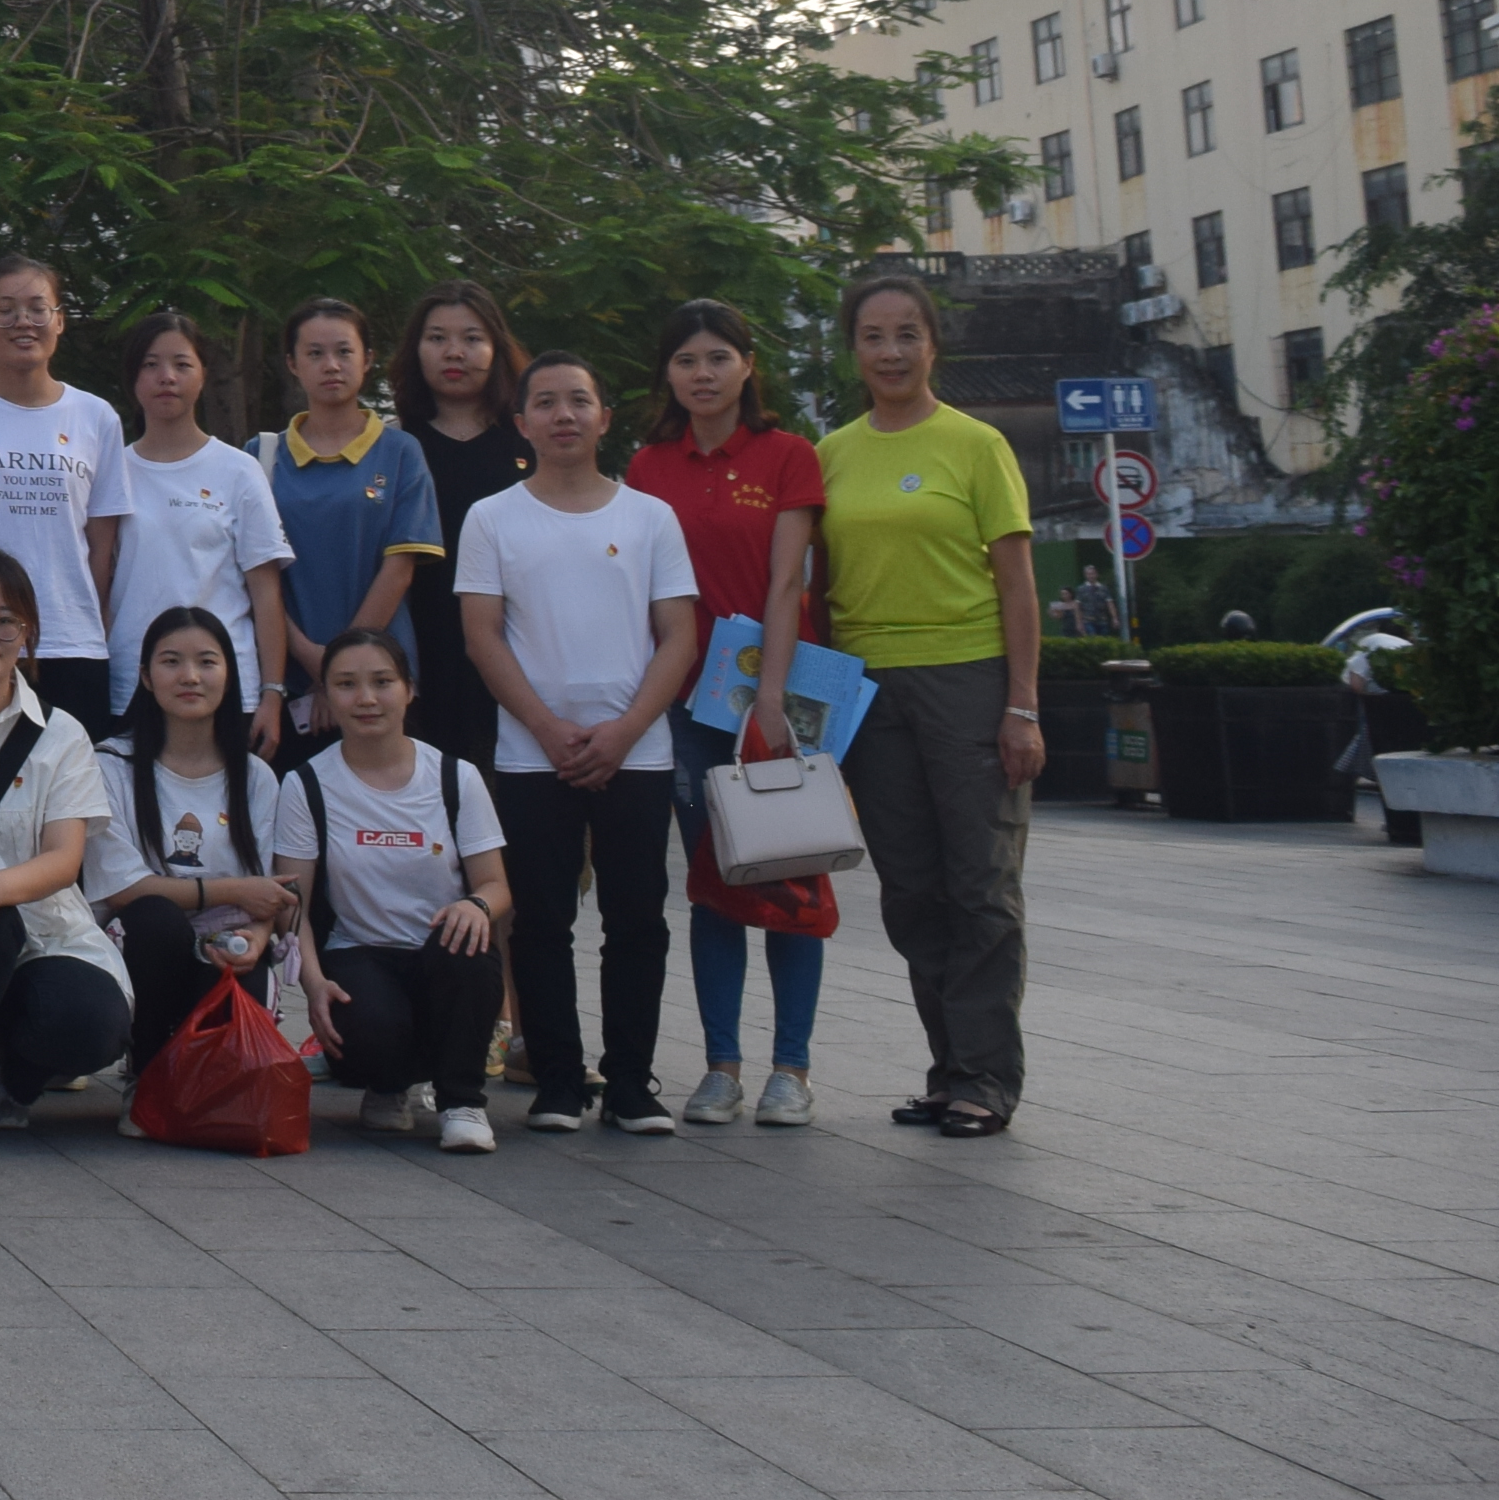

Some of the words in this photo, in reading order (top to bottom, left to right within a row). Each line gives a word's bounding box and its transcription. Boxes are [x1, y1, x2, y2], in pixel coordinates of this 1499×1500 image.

[3, 475, 27, 486] YOU
[29, 476, 64, 487] MUST
[25, 491, 37, 500] IN
[40, 492, 70, 502] LOVE
[169, 498, 182, 508] We
[9, 505, 37, 516] WITH
[40, 506, 58, 516] ME
[363, 832, 417, 846] CAMEL
